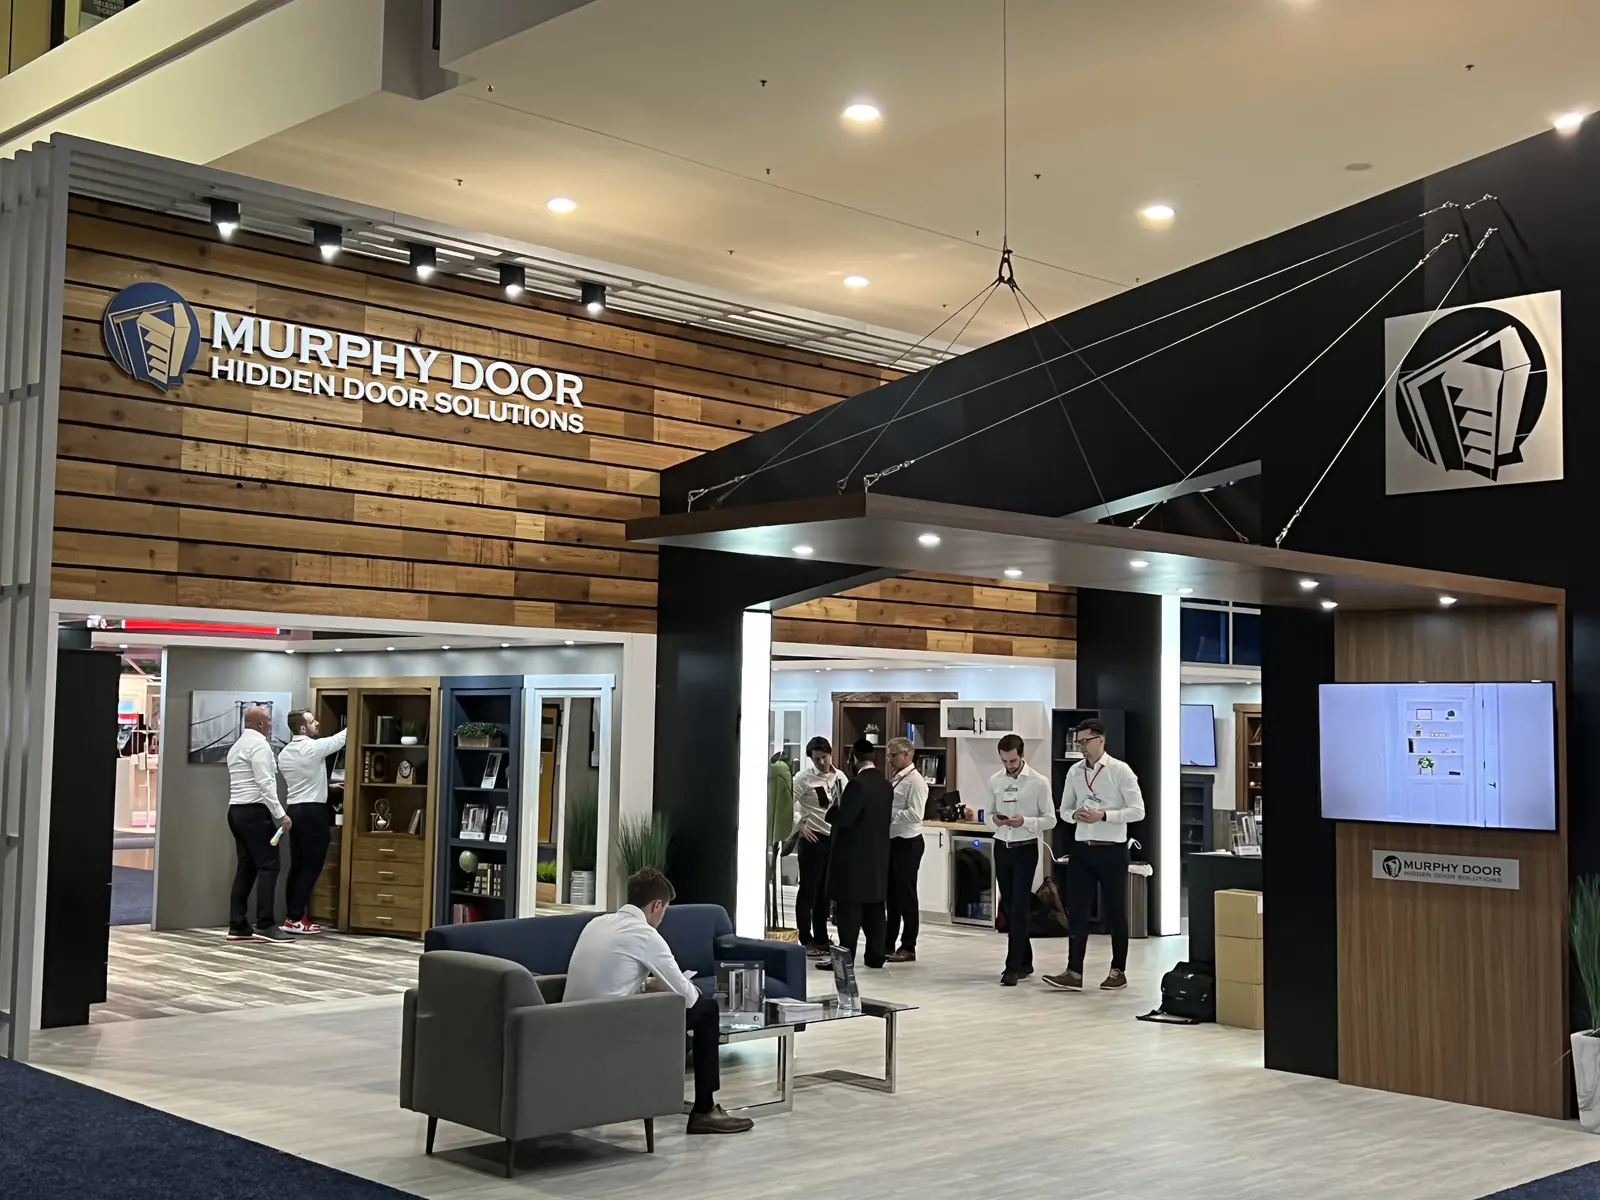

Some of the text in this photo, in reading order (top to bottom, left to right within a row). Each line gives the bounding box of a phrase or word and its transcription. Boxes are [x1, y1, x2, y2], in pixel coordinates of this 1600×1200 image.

[211, 311, 584, 408] MURPHY DOOR
[211, 356, 584, 434] HIDDEN DOOR SOLUTIONS
[1403, 860, 1502, 876] MURPHY DOOR
